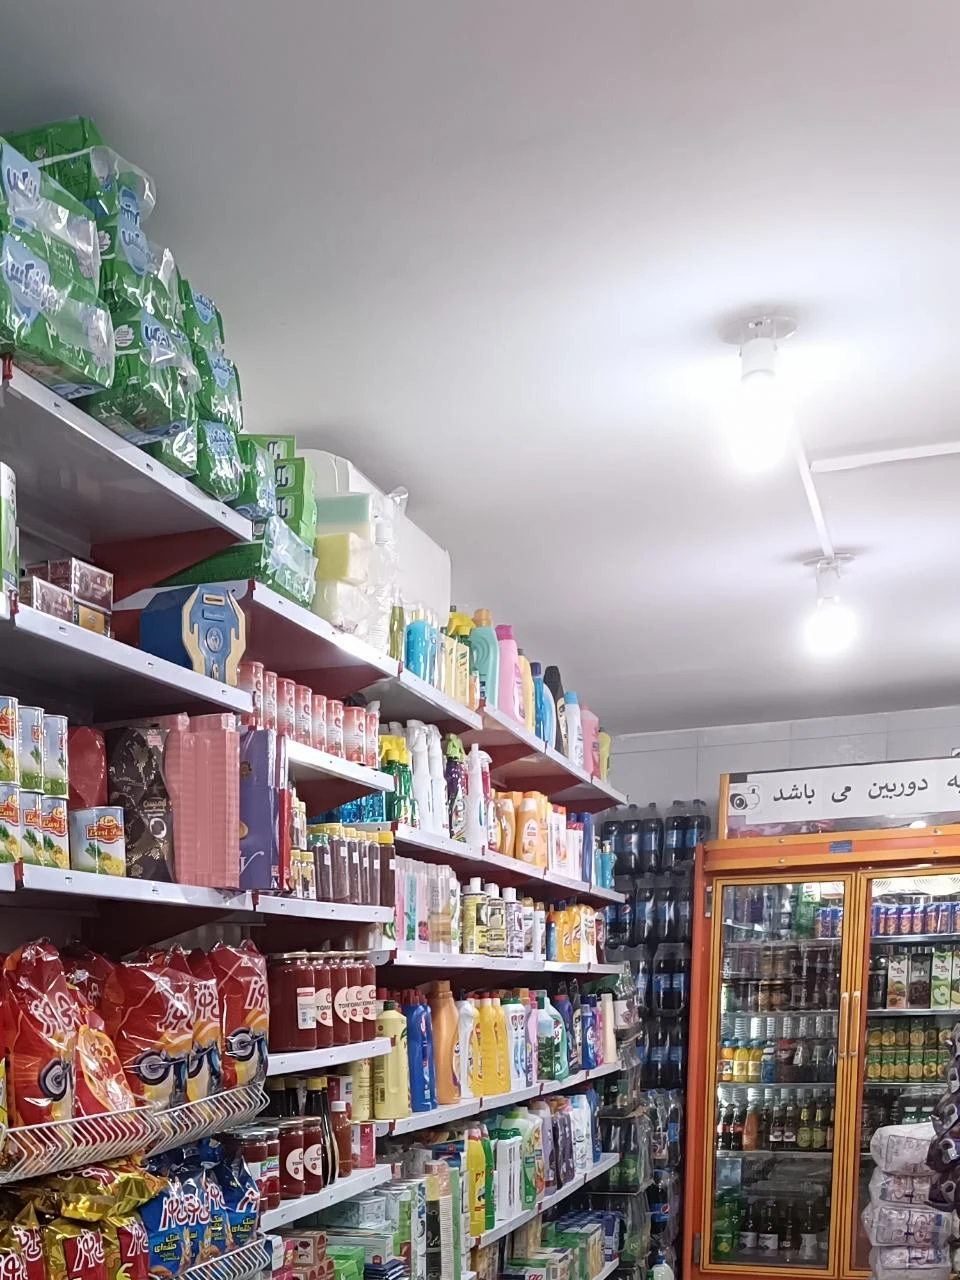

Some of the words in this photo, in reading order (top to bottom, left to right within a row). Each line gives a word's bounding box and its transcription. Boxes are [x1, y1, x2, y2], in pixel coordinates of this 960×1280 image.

[773, 783, 815, 802] باشد
[831, 784, 852, 803] می
[867, 776, 929, 800] دوربین
